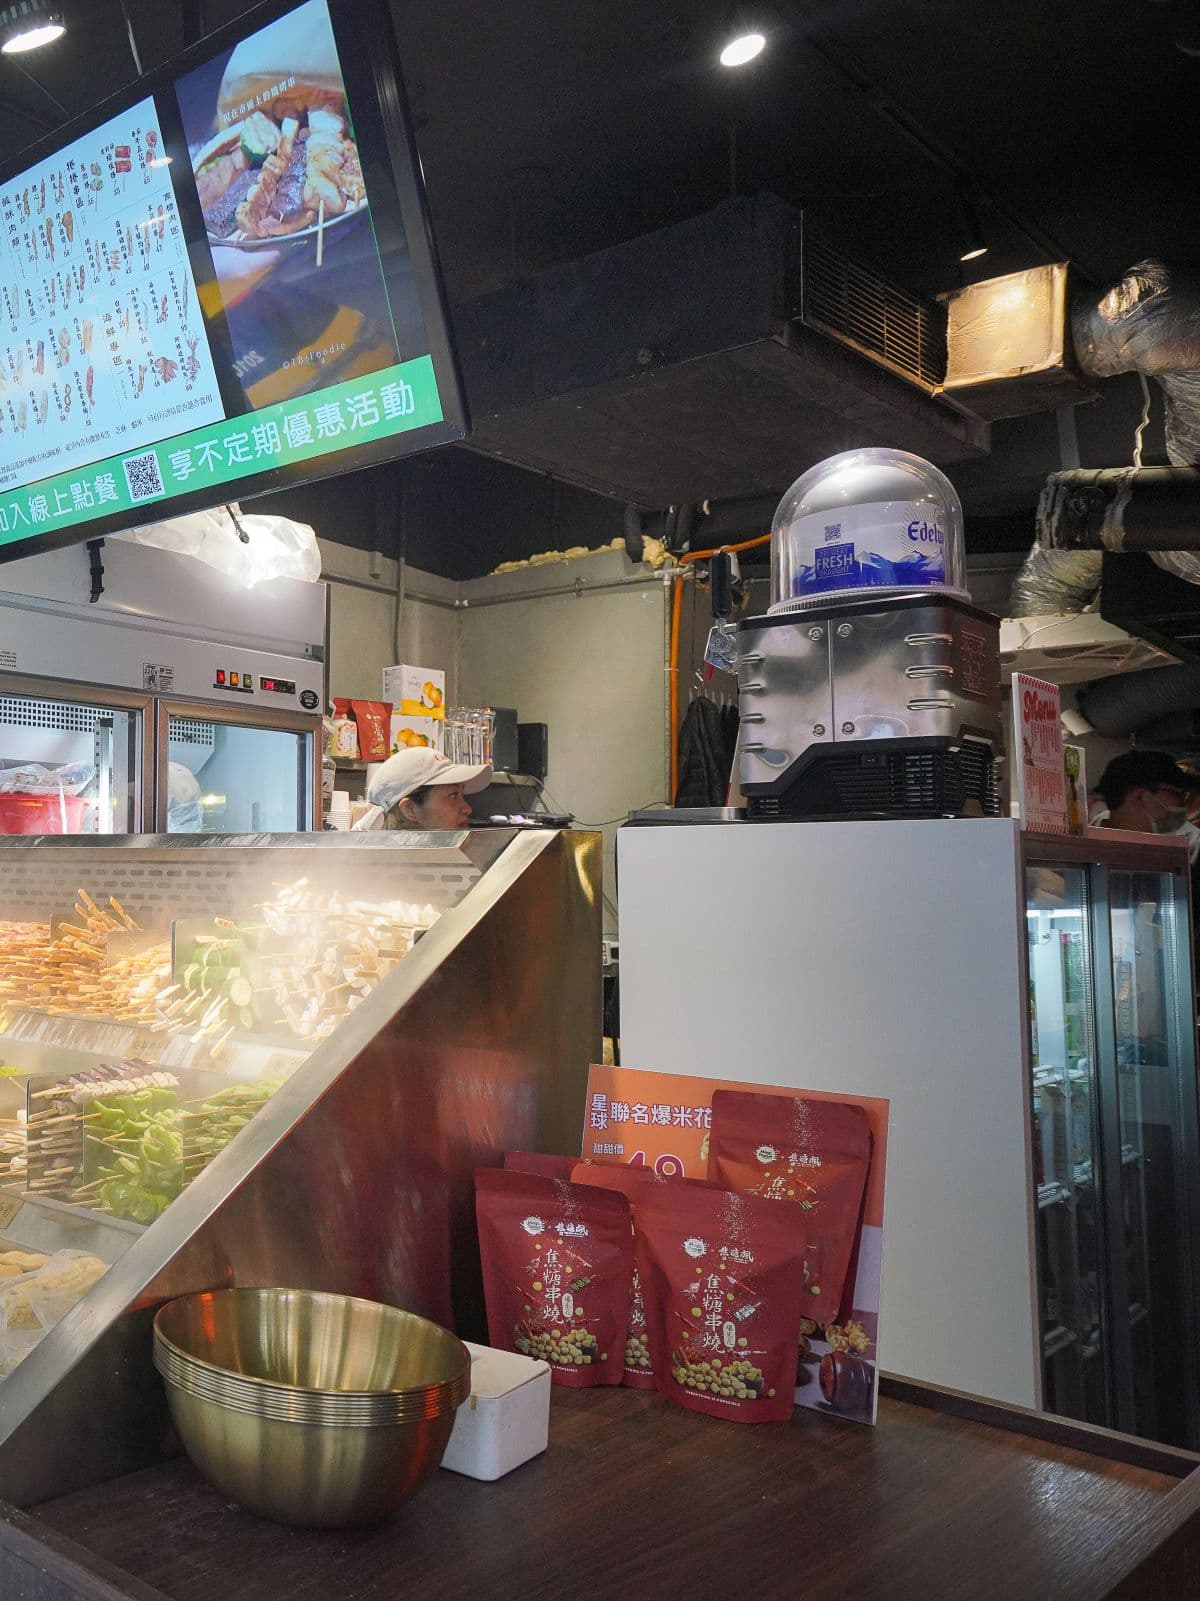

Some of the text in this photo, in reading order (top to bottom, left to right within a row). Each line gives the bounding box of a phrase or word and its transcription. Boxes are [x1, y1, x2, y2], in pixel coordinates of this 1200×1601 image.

[168, 379, 415, 481] 享不定期優惠活動
[816, 553, 853, 570] FRESH
[543, 1249, 564, 1325] 焦糖串燒
[702, 1274, 725, 1354] 焦糖串燒
